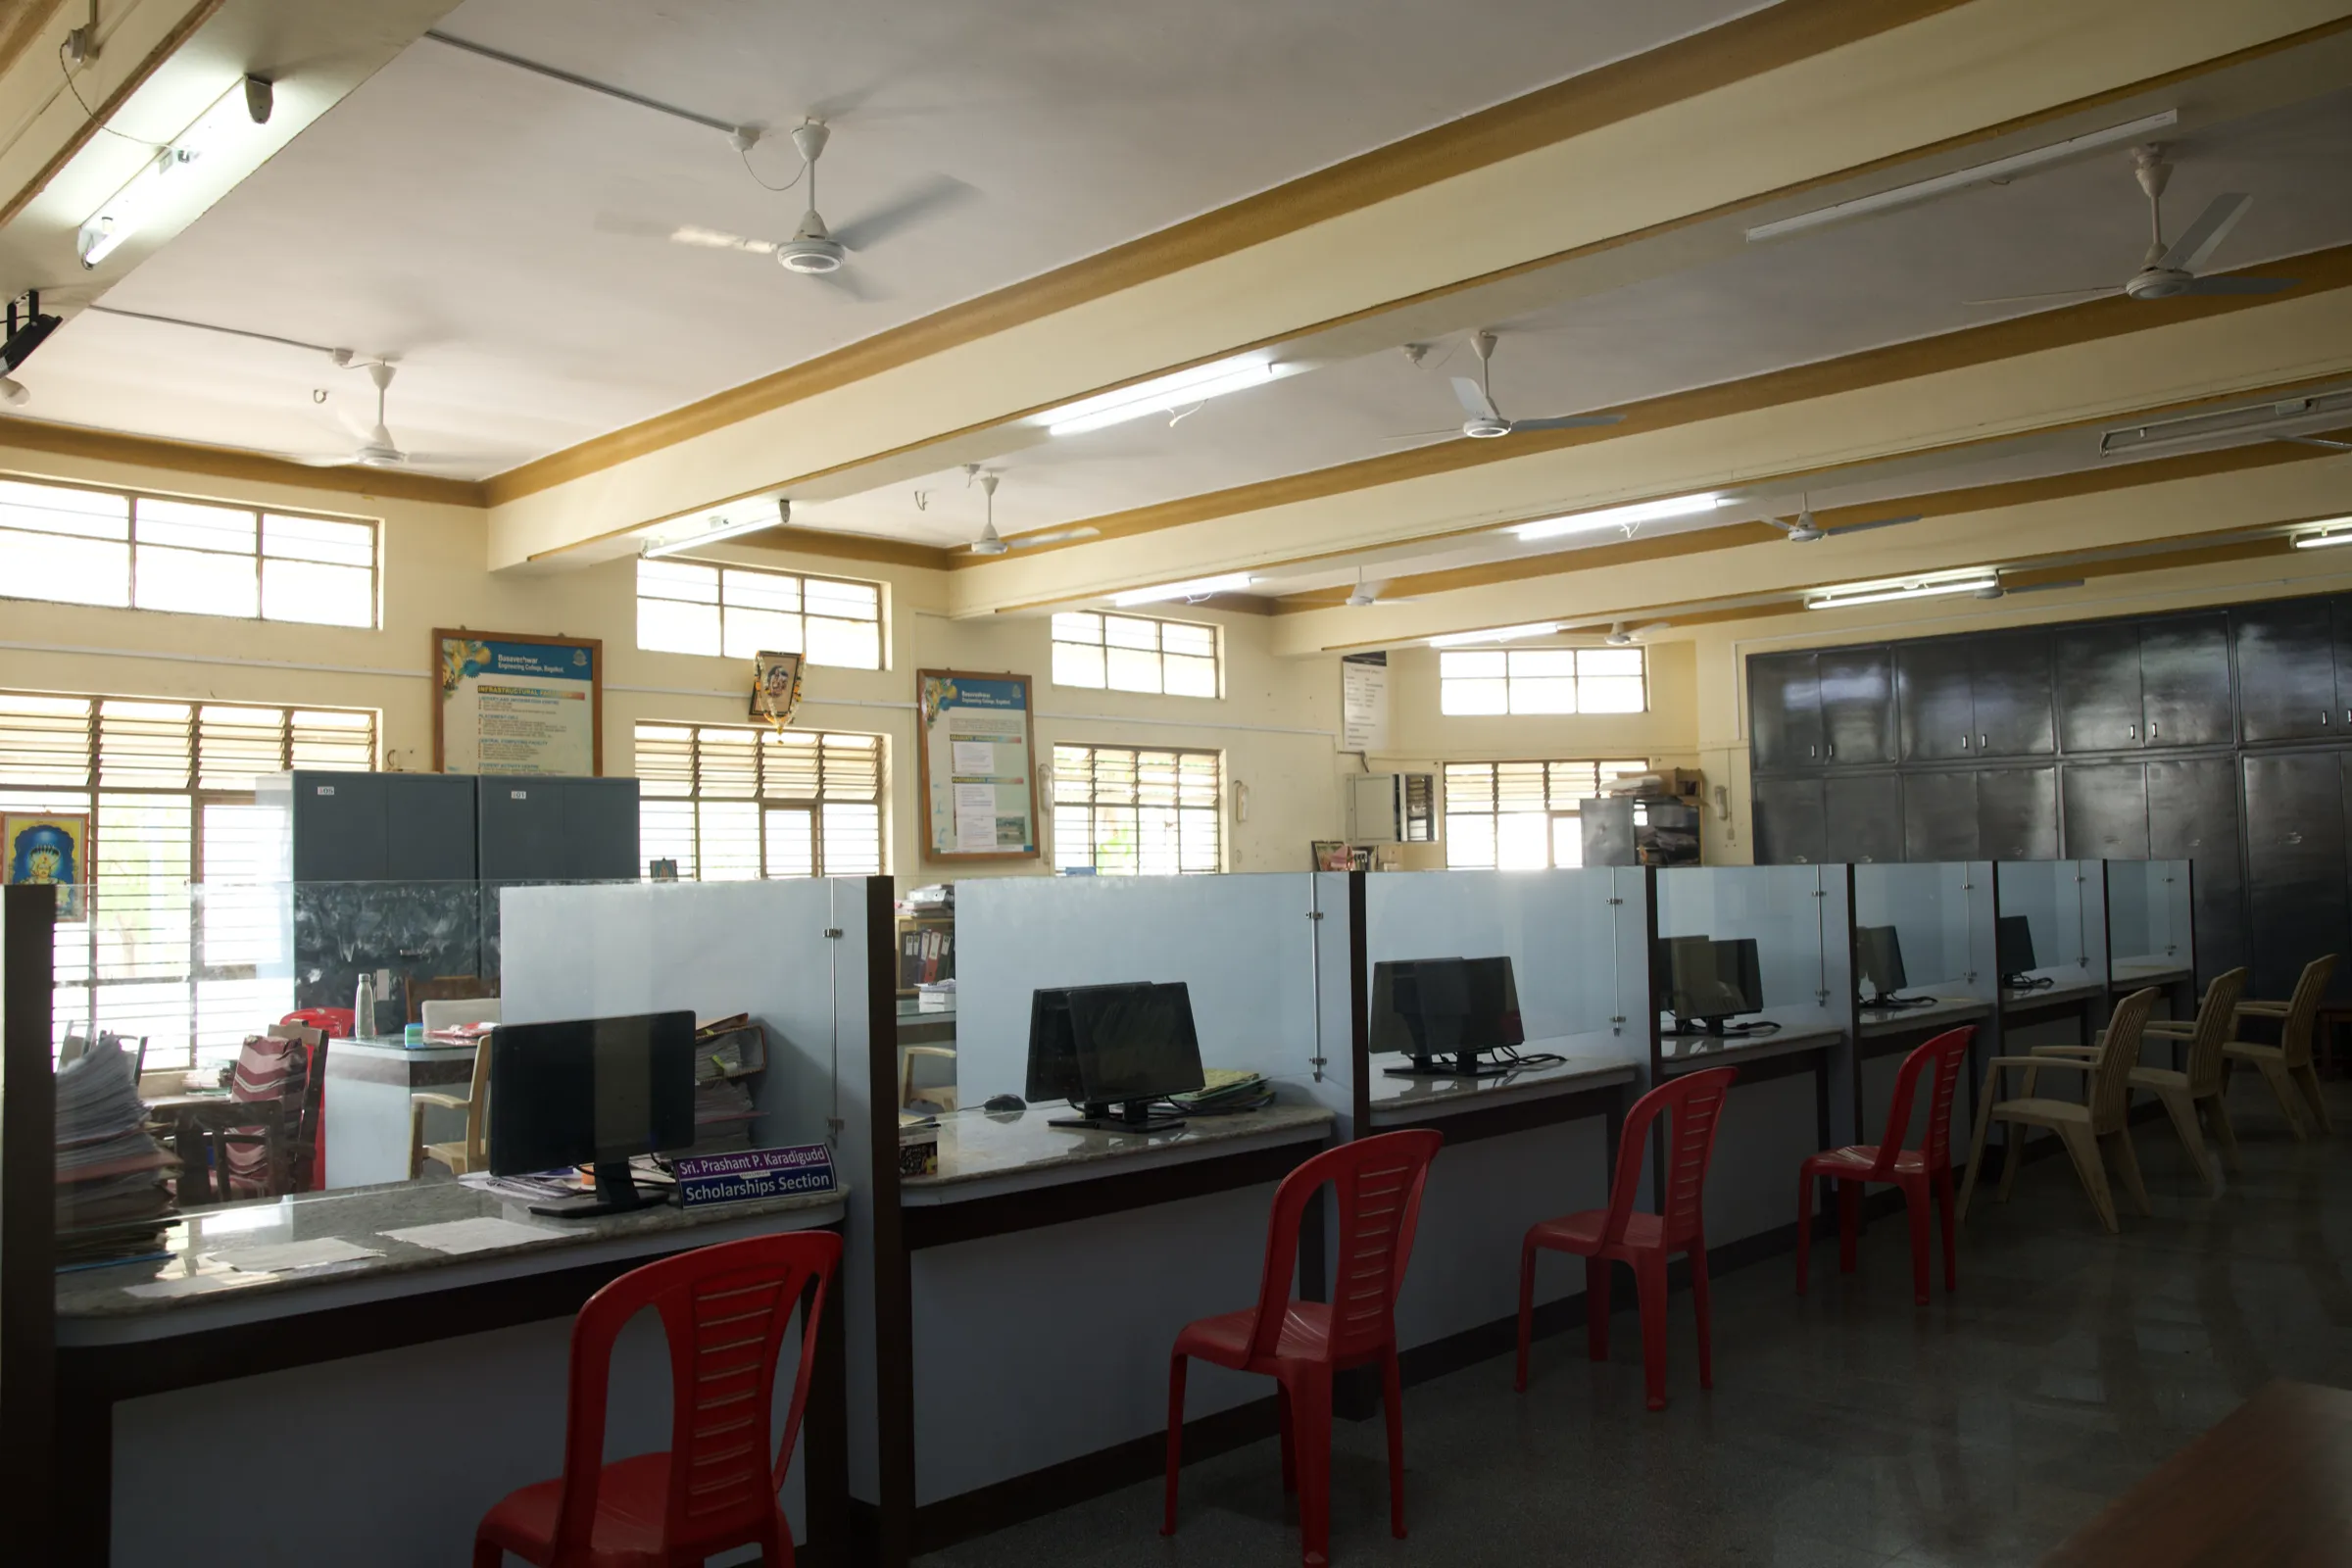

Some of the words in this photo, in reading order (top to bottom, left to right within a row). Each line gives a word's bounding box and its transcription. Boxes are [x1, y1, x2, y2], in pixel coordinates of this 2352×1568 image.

[478, 686, 539, 695] INFRASTRUCTURAL
[679, 1160, 700, 1175] Sri.
[701, 1156, 752, 1173] Prashant
[752, 1154, 763, 1168] P.
[763, 1148, 825, 1165] Karadigudd
[686, 1179, 776, 1201] Scholarships
[778, 1173, 830, 1190] Section
